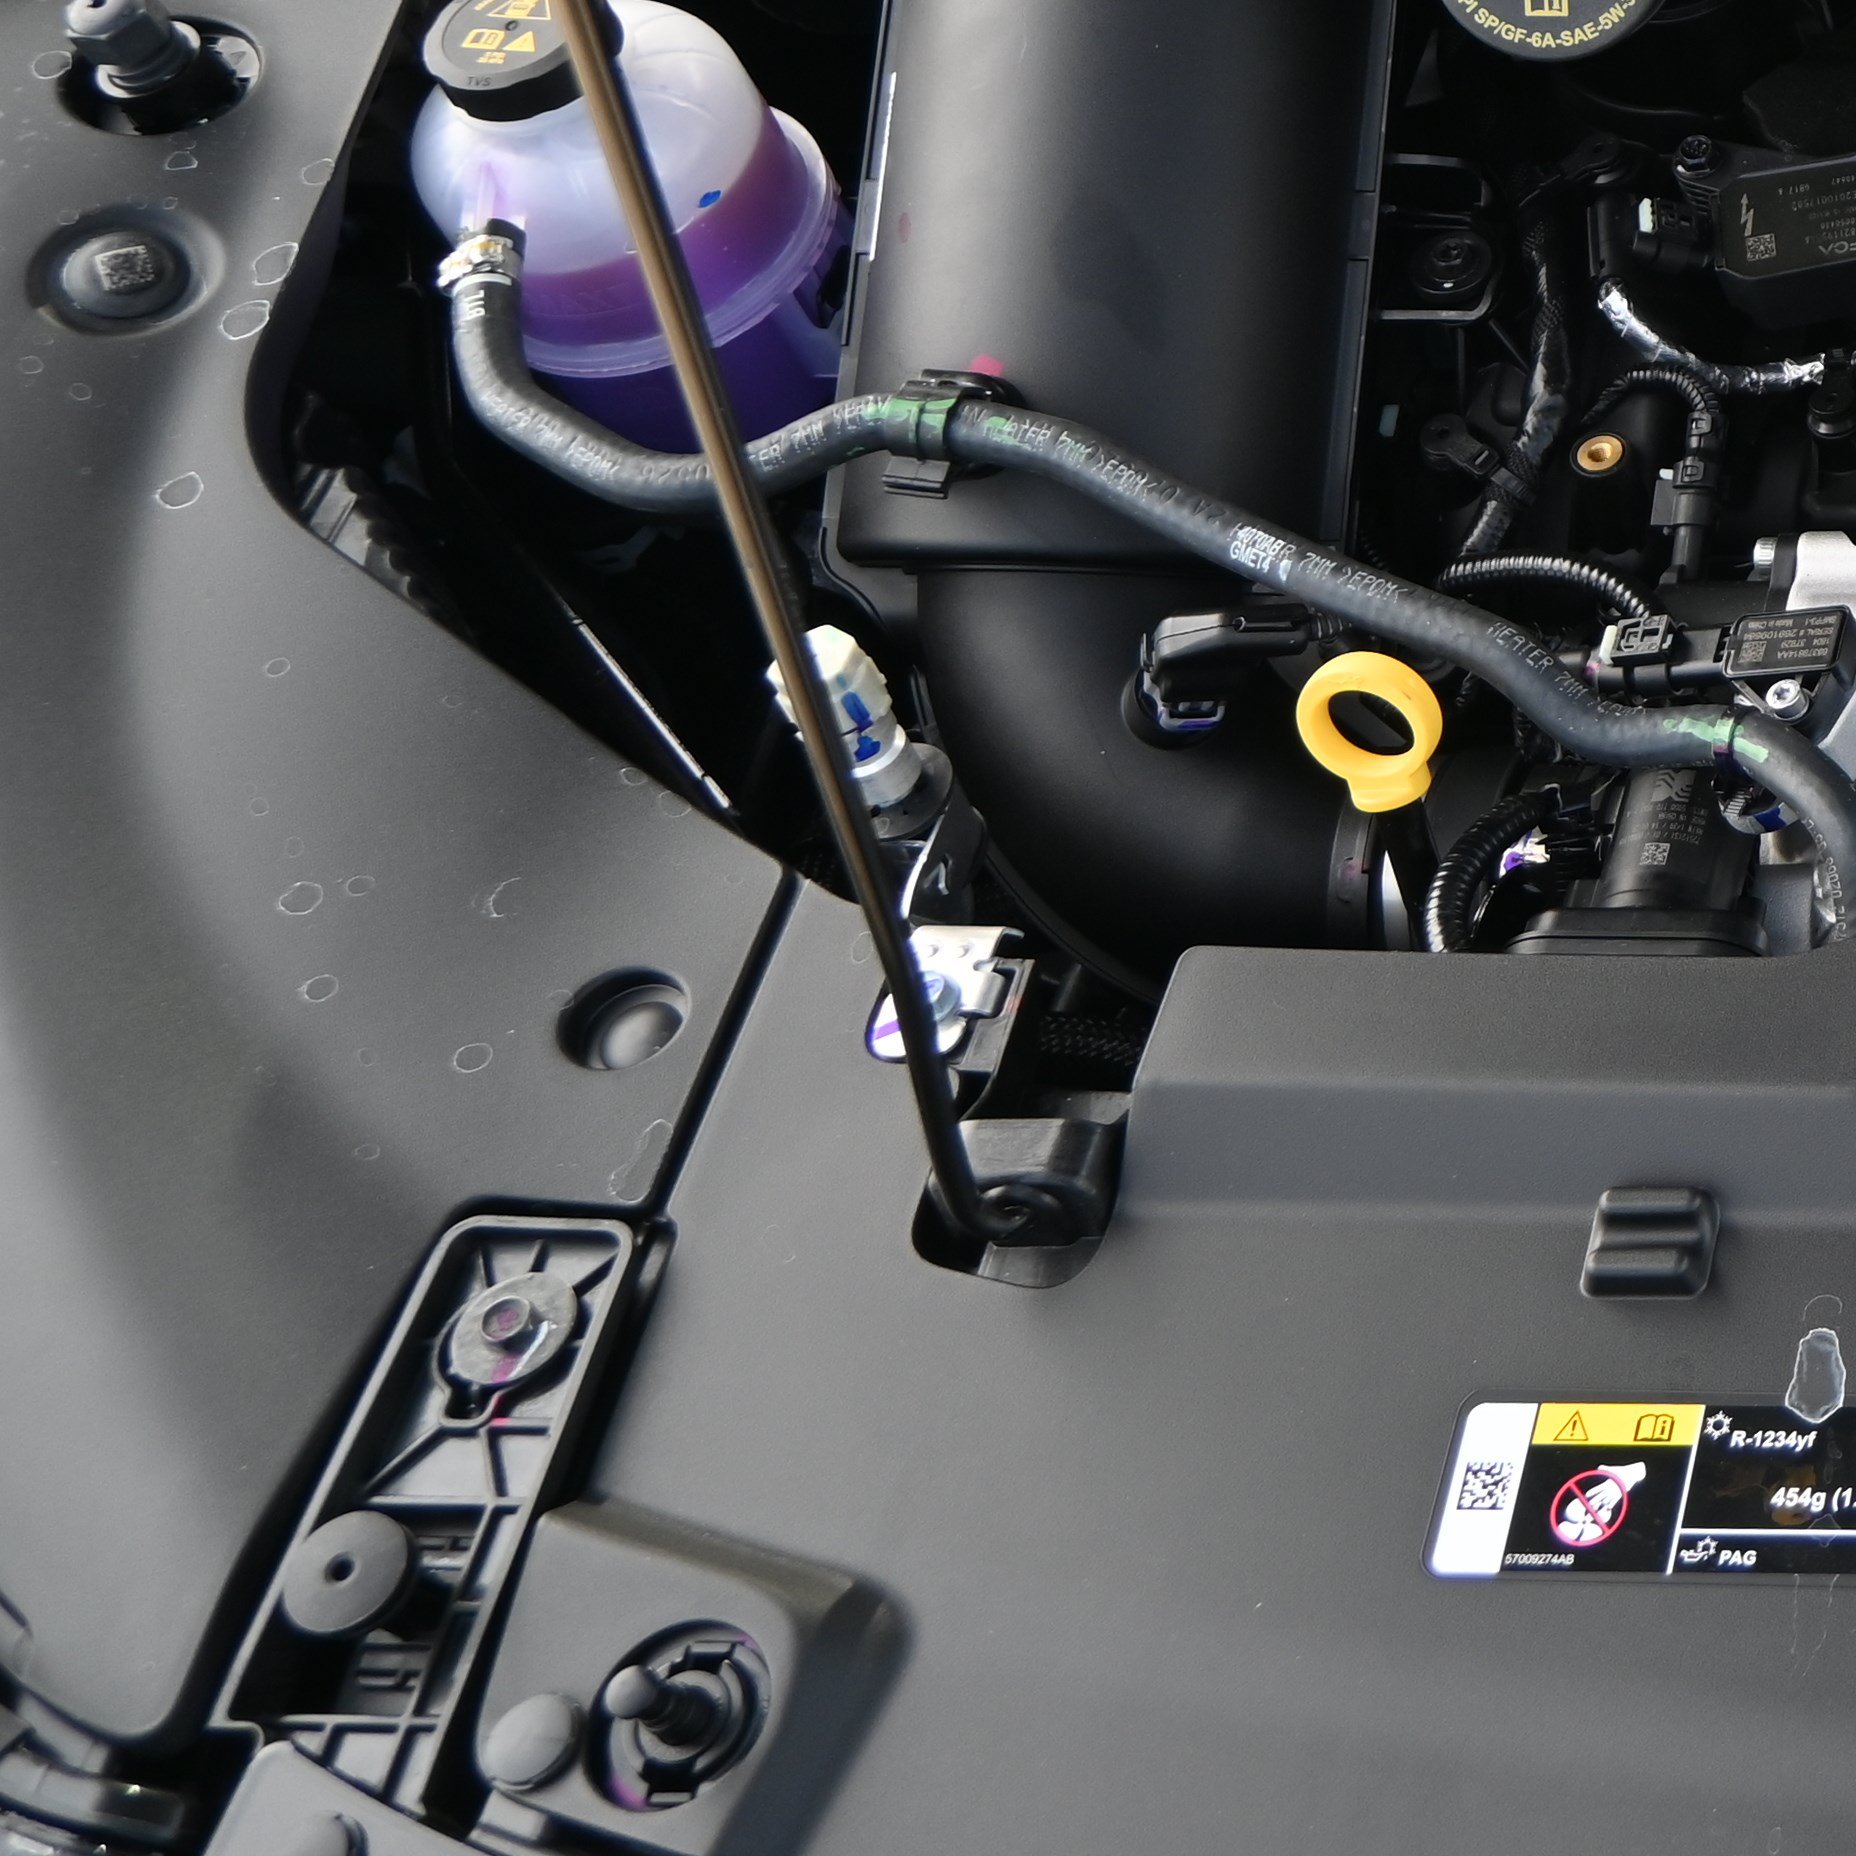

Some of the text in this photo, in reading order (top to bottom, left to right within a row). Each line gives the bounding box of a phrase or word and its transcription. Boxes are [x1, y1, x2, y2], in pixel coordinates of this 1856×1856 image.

[467, 76, 492, 87] TVS
[1486, 620, 1555, 675] HEATER
[1731, 1431, 1817, 1452] R-1234yf
[1771, 1487, 1827, 1512] 454g
[1718, 1550, 1758, 1566] PAG
